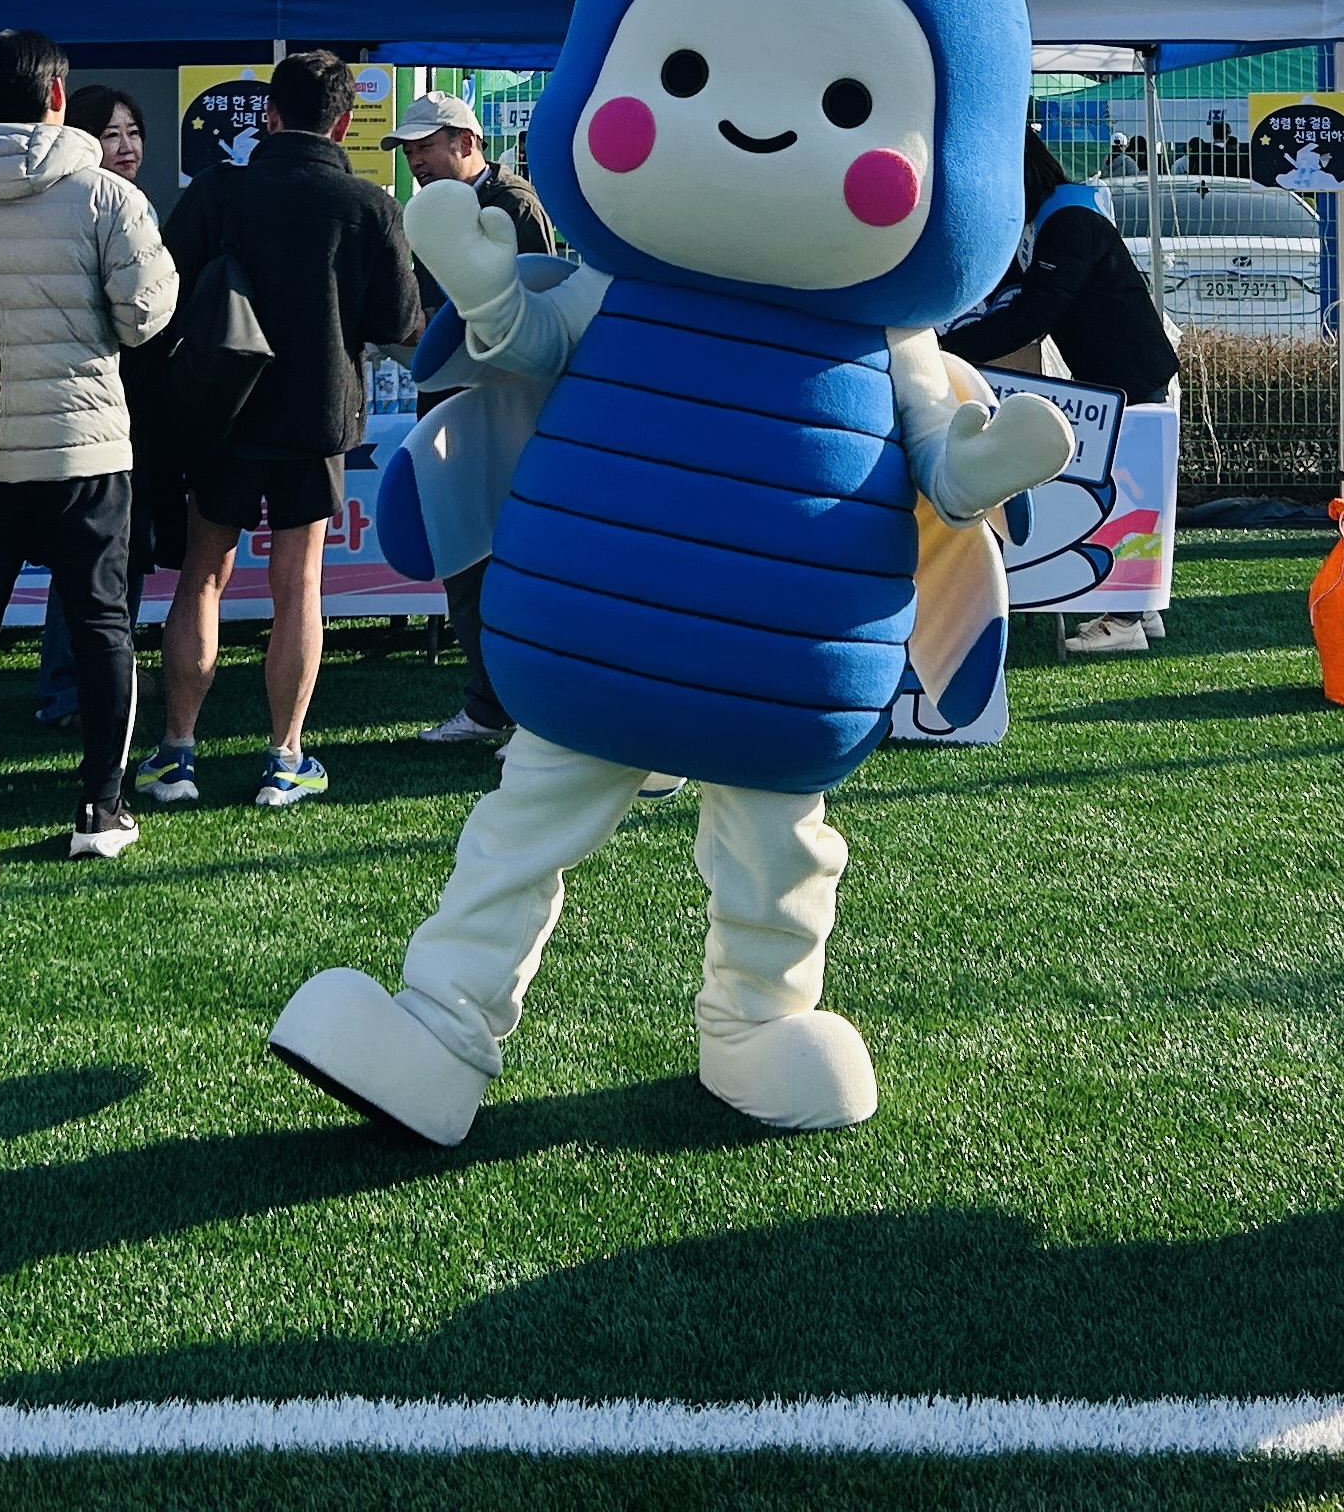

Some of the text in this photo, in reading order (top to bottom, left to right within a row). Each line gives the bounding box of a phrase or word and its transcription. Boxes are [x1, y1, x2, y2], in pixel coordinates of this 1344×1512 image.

[202, 95, 228, 111] 청렴
[232, 95, 246, 111] 한
[230, 111, 257, 128] 신뢰
[1269, 116, 1332, 131] 청렴 한 걸음
[1293, 129, 1317, 144] 신뢰
